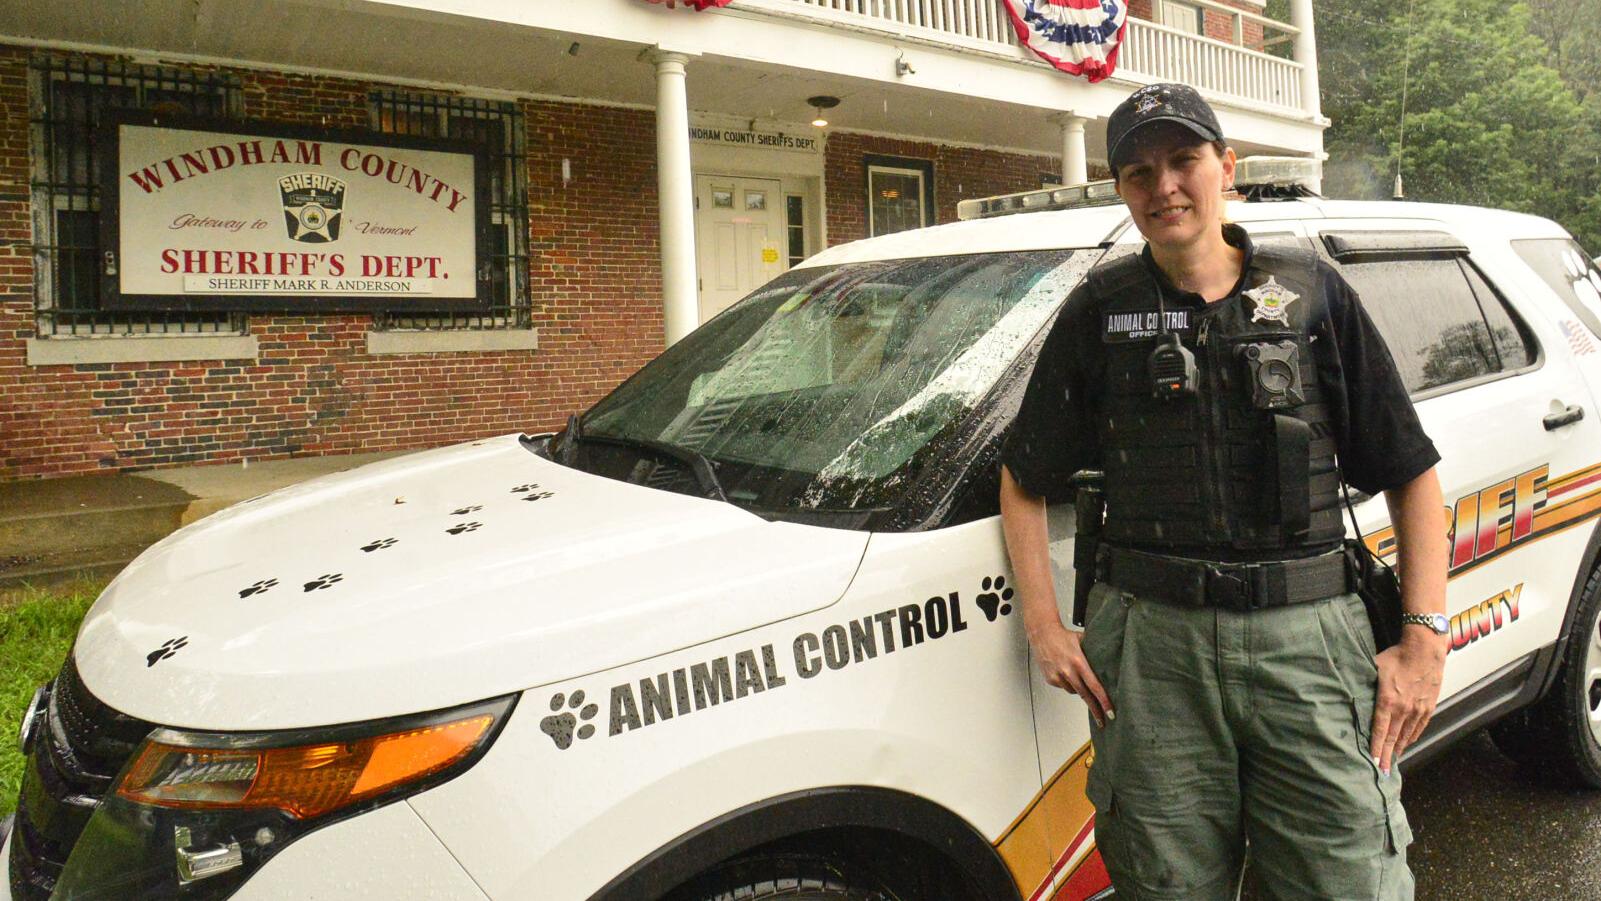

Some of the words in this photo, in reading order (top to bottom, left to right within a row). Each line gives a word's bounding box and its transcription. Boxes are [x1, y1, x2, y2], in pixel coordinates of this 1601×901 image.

[688, 127, 721, 141] INDHAM
[723, 131, 756, 144] COUNTY
[127, 139, 322, 194] WINDHAM
[339, 148, 468, 214] COUNTY
[280, 173, 345, 195] SHERIFF
[168, 213, 245, 233] Gateway
[250, 218, 269, 230] to
[354, 221, 418, 236] Vermont
[160, 248, 345, 277] SHERIFF'S
[360, 254, 449, 280] DEPT.
[208, 278, 271, 290] SHERIFF
[273, 279, 317, 291] MARK
[335, 280, 411, 292] ANDERSON
[1107, 312, 1143, 333] ANIMAL
[1146, 311, 1189, 330] COTROL
[1128, 330, 1159, 338] OFFICE
[1446, 583, 1524, 656] UNTY
[608, 643, 786, 738] ANIMAL
[792, 591, 968, 680] CONTROL
